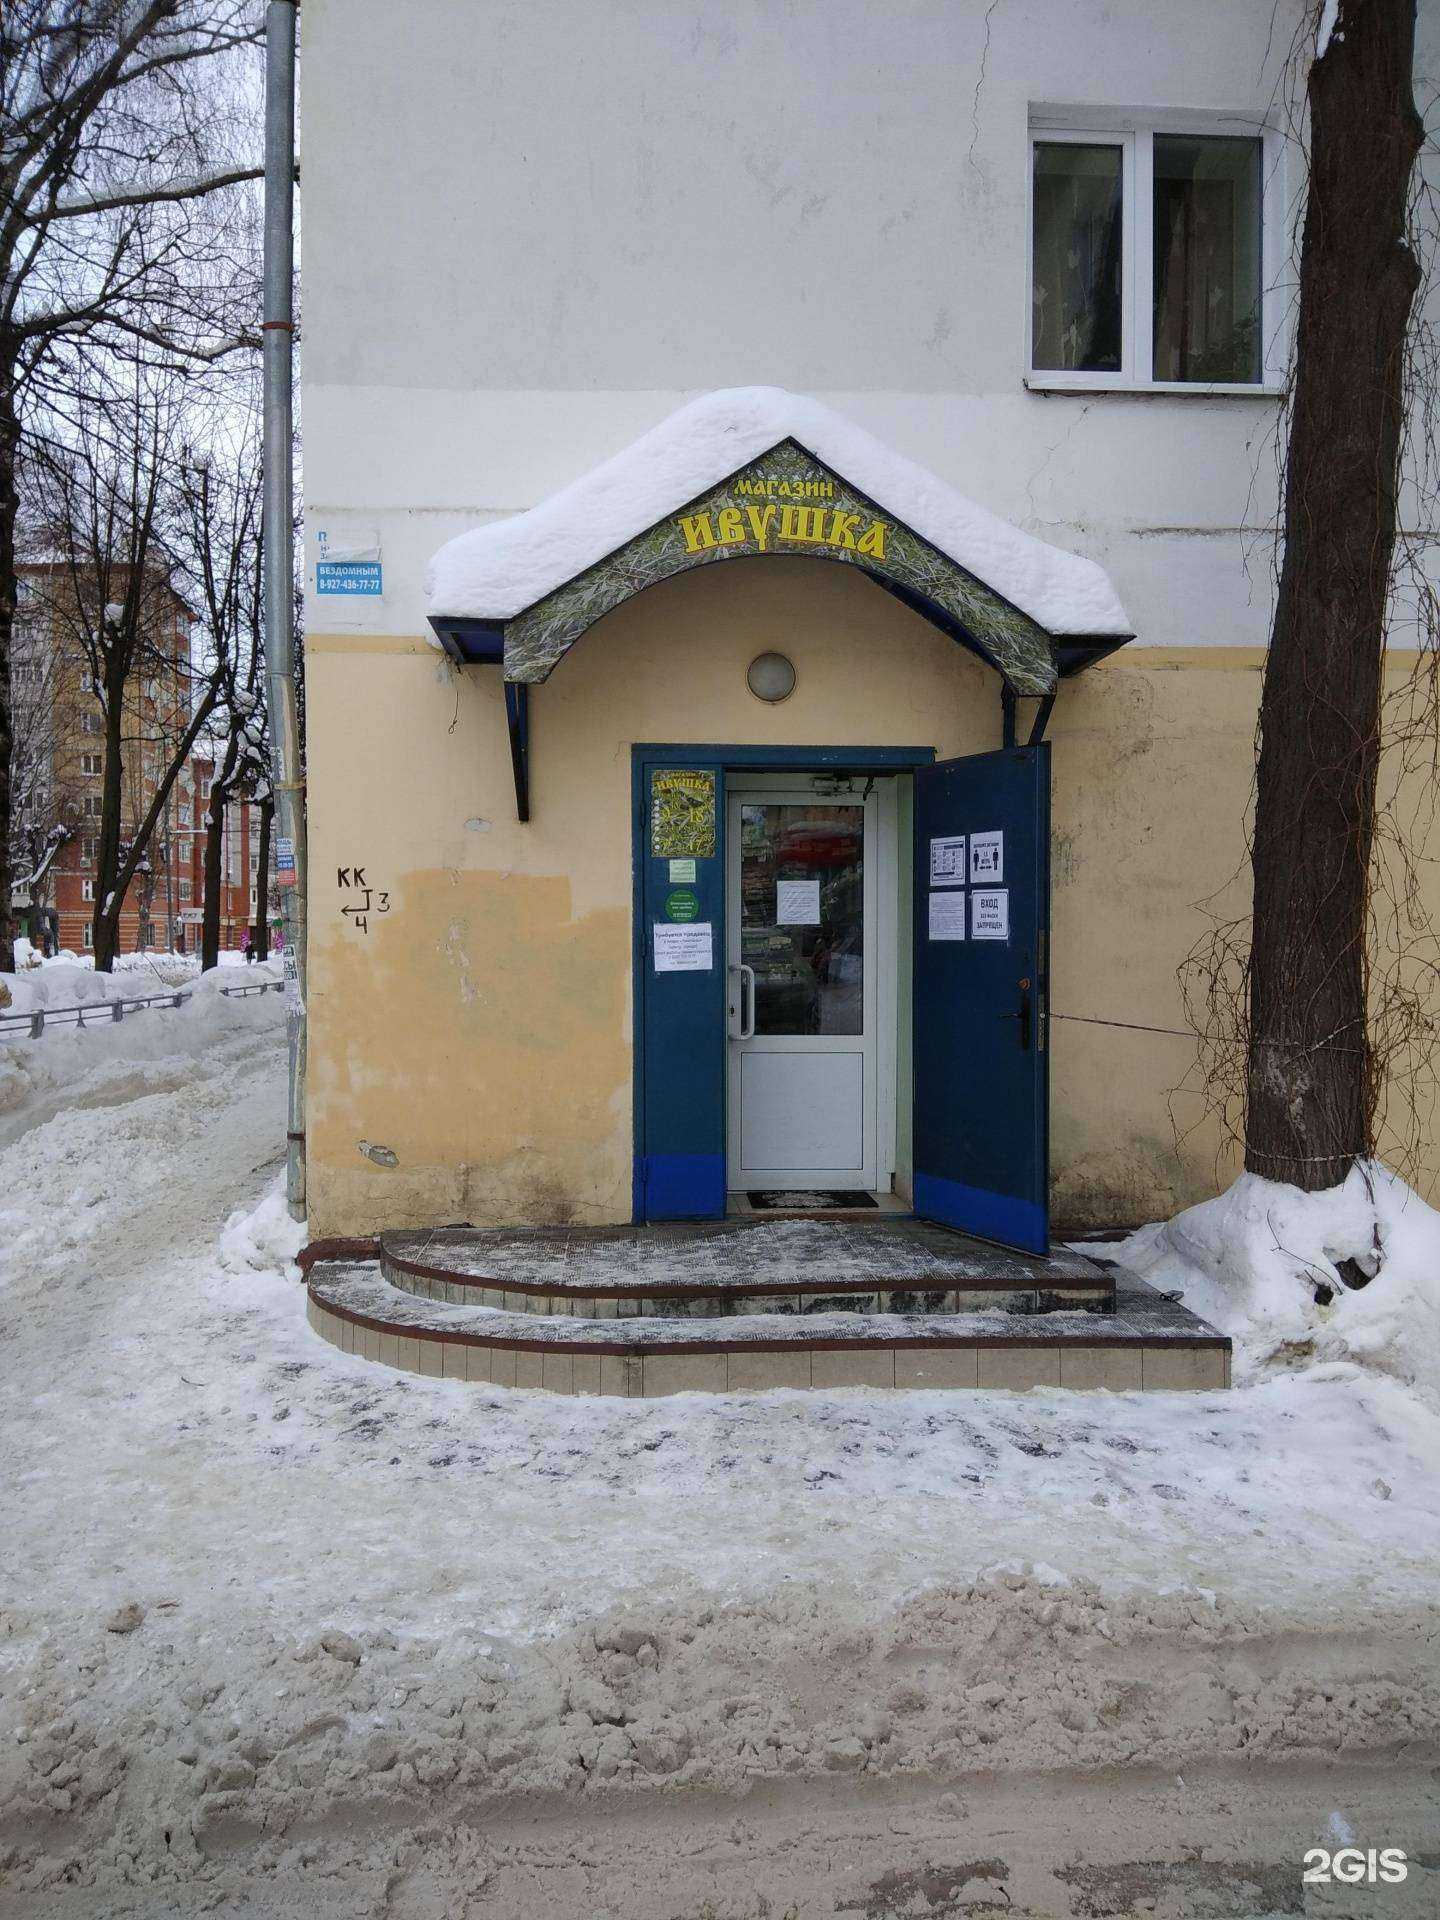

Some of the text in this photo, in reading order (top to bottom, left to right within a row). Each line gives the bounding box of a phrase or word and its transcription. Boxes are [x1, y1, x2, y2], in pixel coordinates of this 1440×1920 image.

[678, 503, 888, 561] ИВУШКА
[319, 566, 379, 576] БЕЗДОМНЫМ
[319, 579, 380, 590] 8-927-436-77-77
[377, 892, 391, 913] 3
[980, 898, 999, 910] ВХОД
[355, 915, 368, 934] 4
